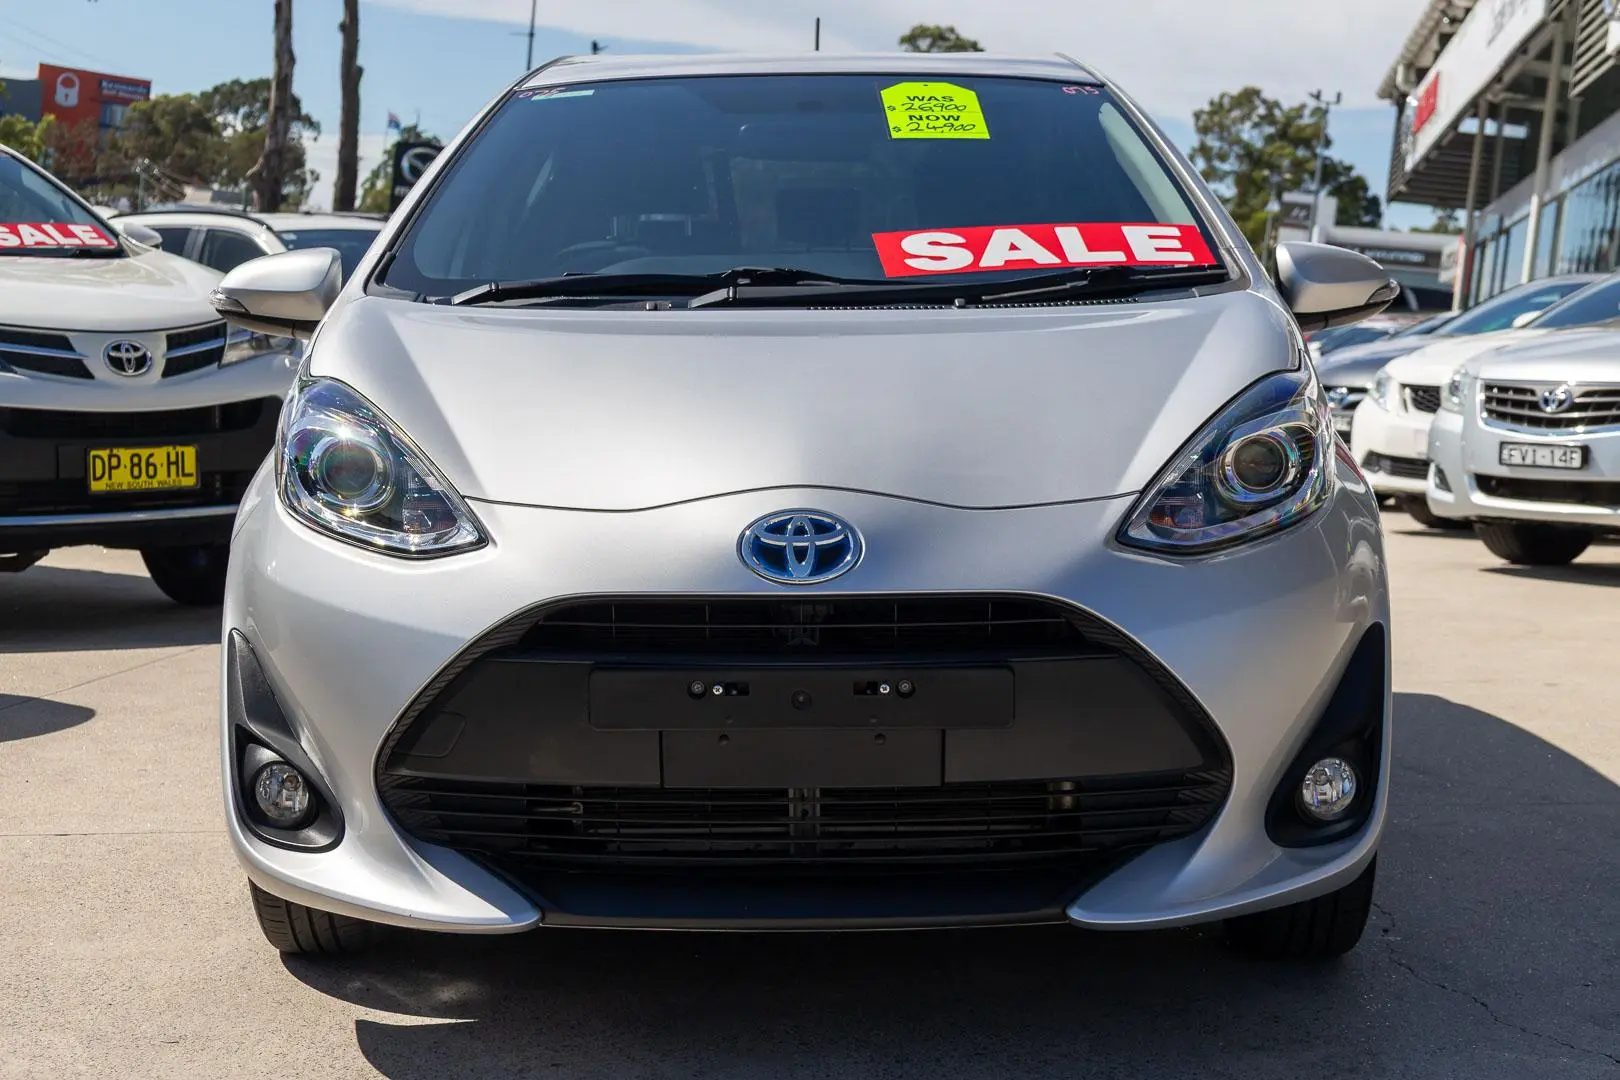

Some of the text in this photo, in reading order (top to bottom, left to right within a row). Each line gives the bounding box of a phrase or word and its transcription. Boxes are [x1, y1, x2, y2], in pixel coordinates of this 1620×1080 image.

[908, 114, 961, 122] NOW
[900, 225, 1195, 271] SALE
[105, 479, 183, 490] NEW SOUTH WALES
